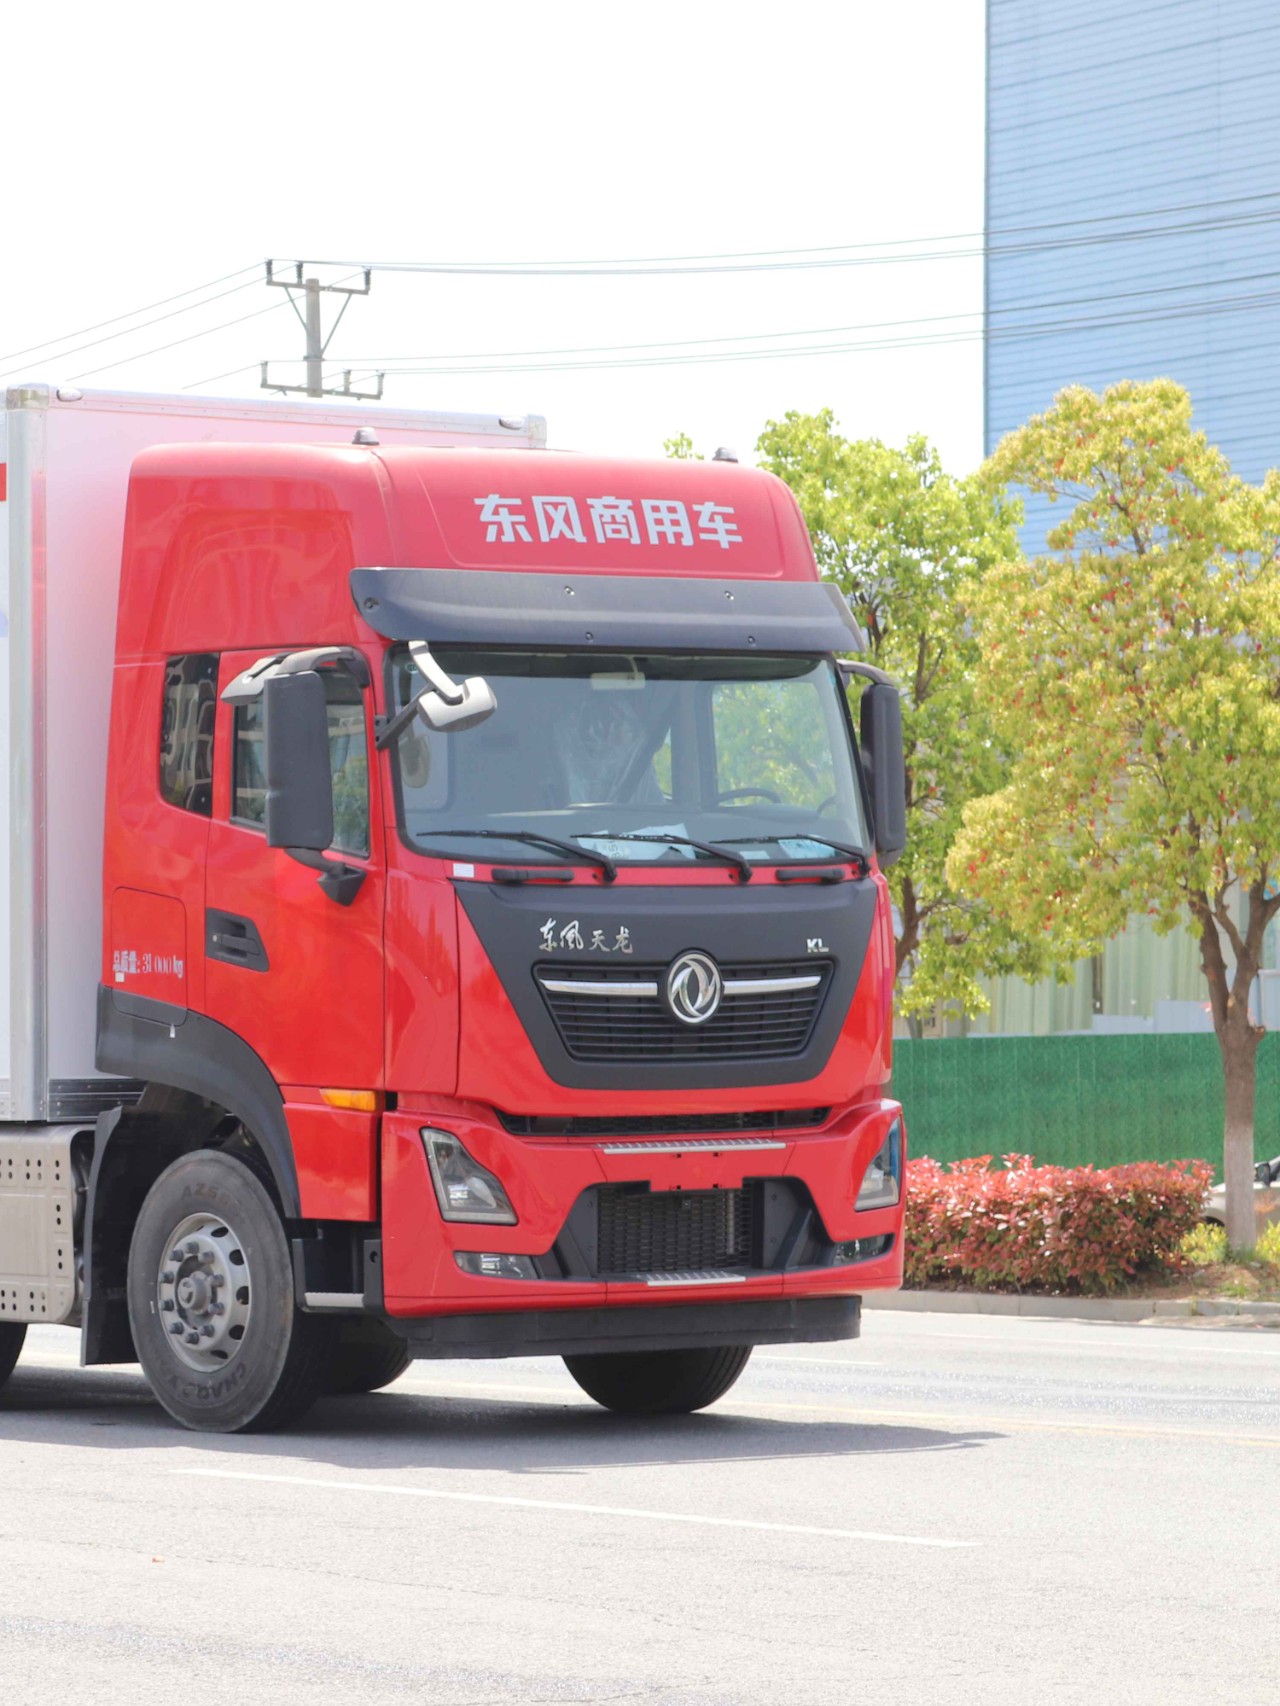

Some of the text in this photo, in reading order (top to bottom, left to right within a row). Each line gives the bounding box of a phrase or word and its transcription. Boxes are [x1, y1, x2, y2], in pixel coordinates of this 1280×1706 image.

[474, 494, 743, 548] 东风商用车
[806, 937, 830, 954] KL
